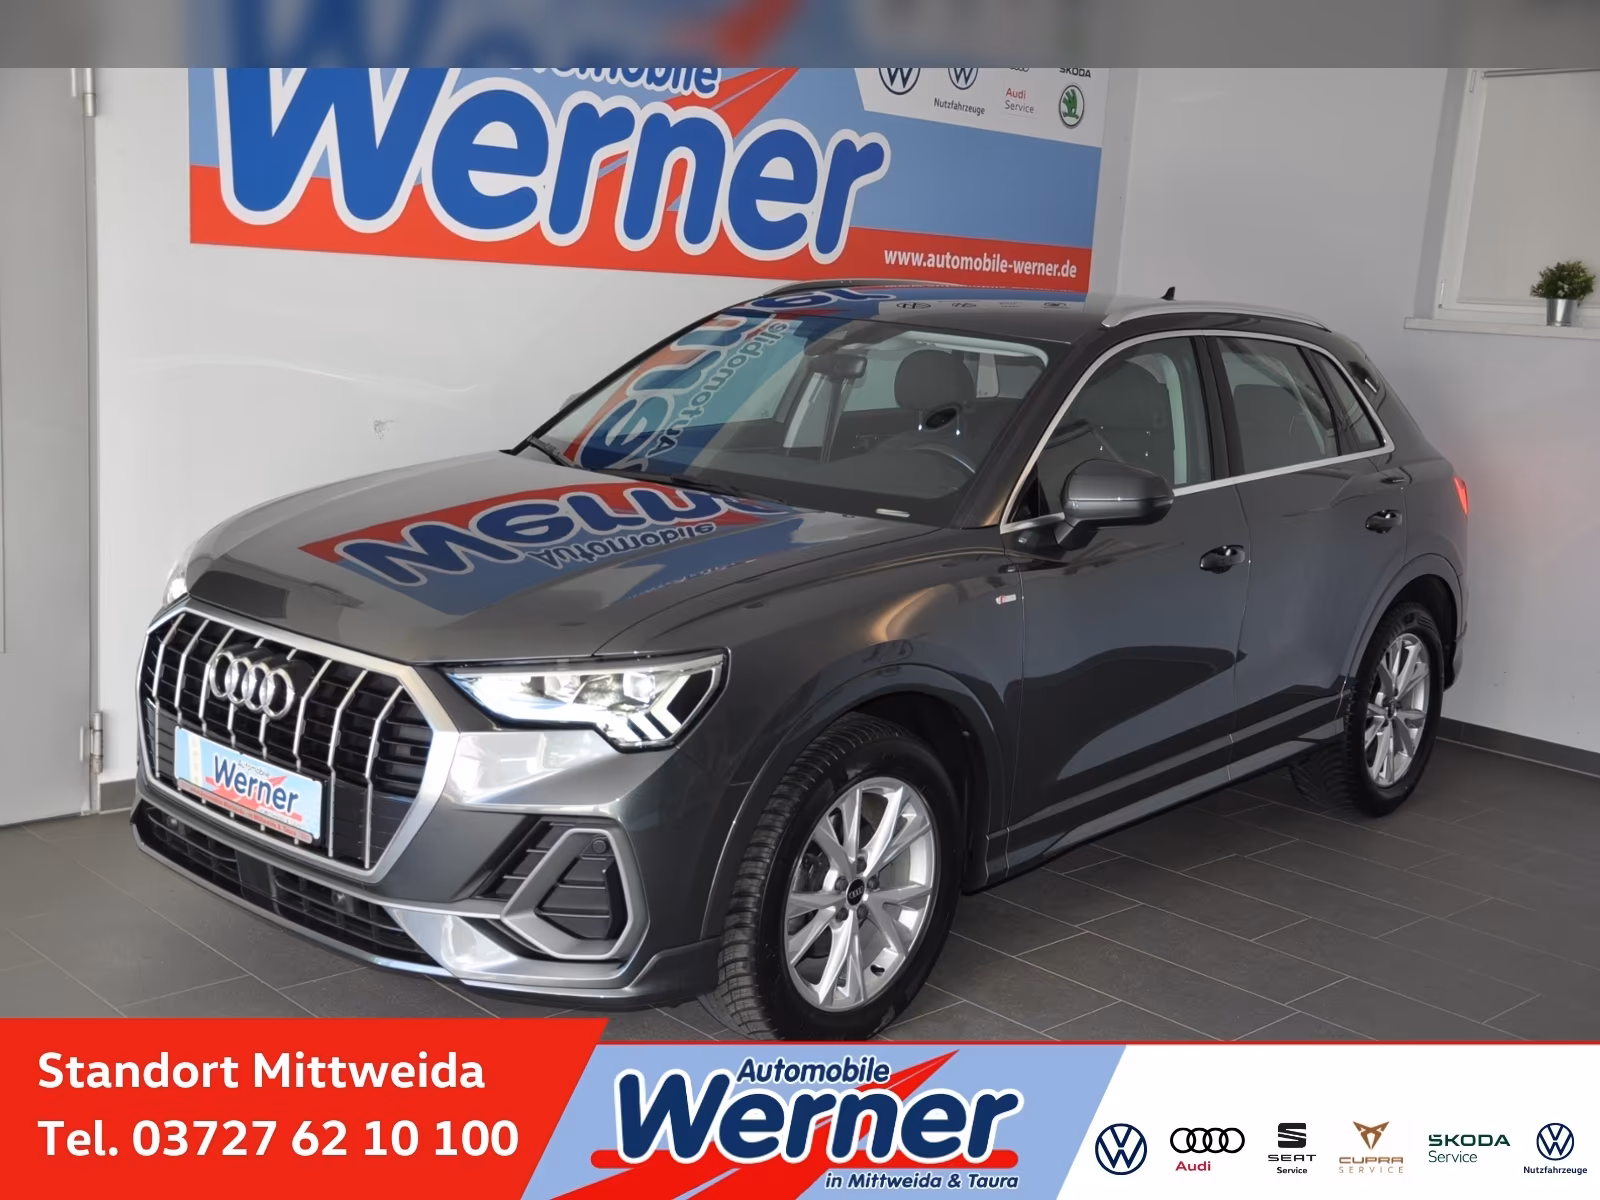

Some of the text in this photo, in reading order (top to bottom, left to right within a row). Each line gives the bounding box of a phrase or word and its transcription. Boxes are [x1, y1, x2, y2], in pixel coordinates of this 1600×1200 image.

[1006, 87, 1026, 99] Audi
[933, 97, 985, 116] Nutzfahrzeuge
[1005, 100, 1035, 113] Service
[218, 67, 885, 260] Werner
[884, 250, 1077, 278] www.automobile-werner.de
[214, 755, 299, 813] Werner
